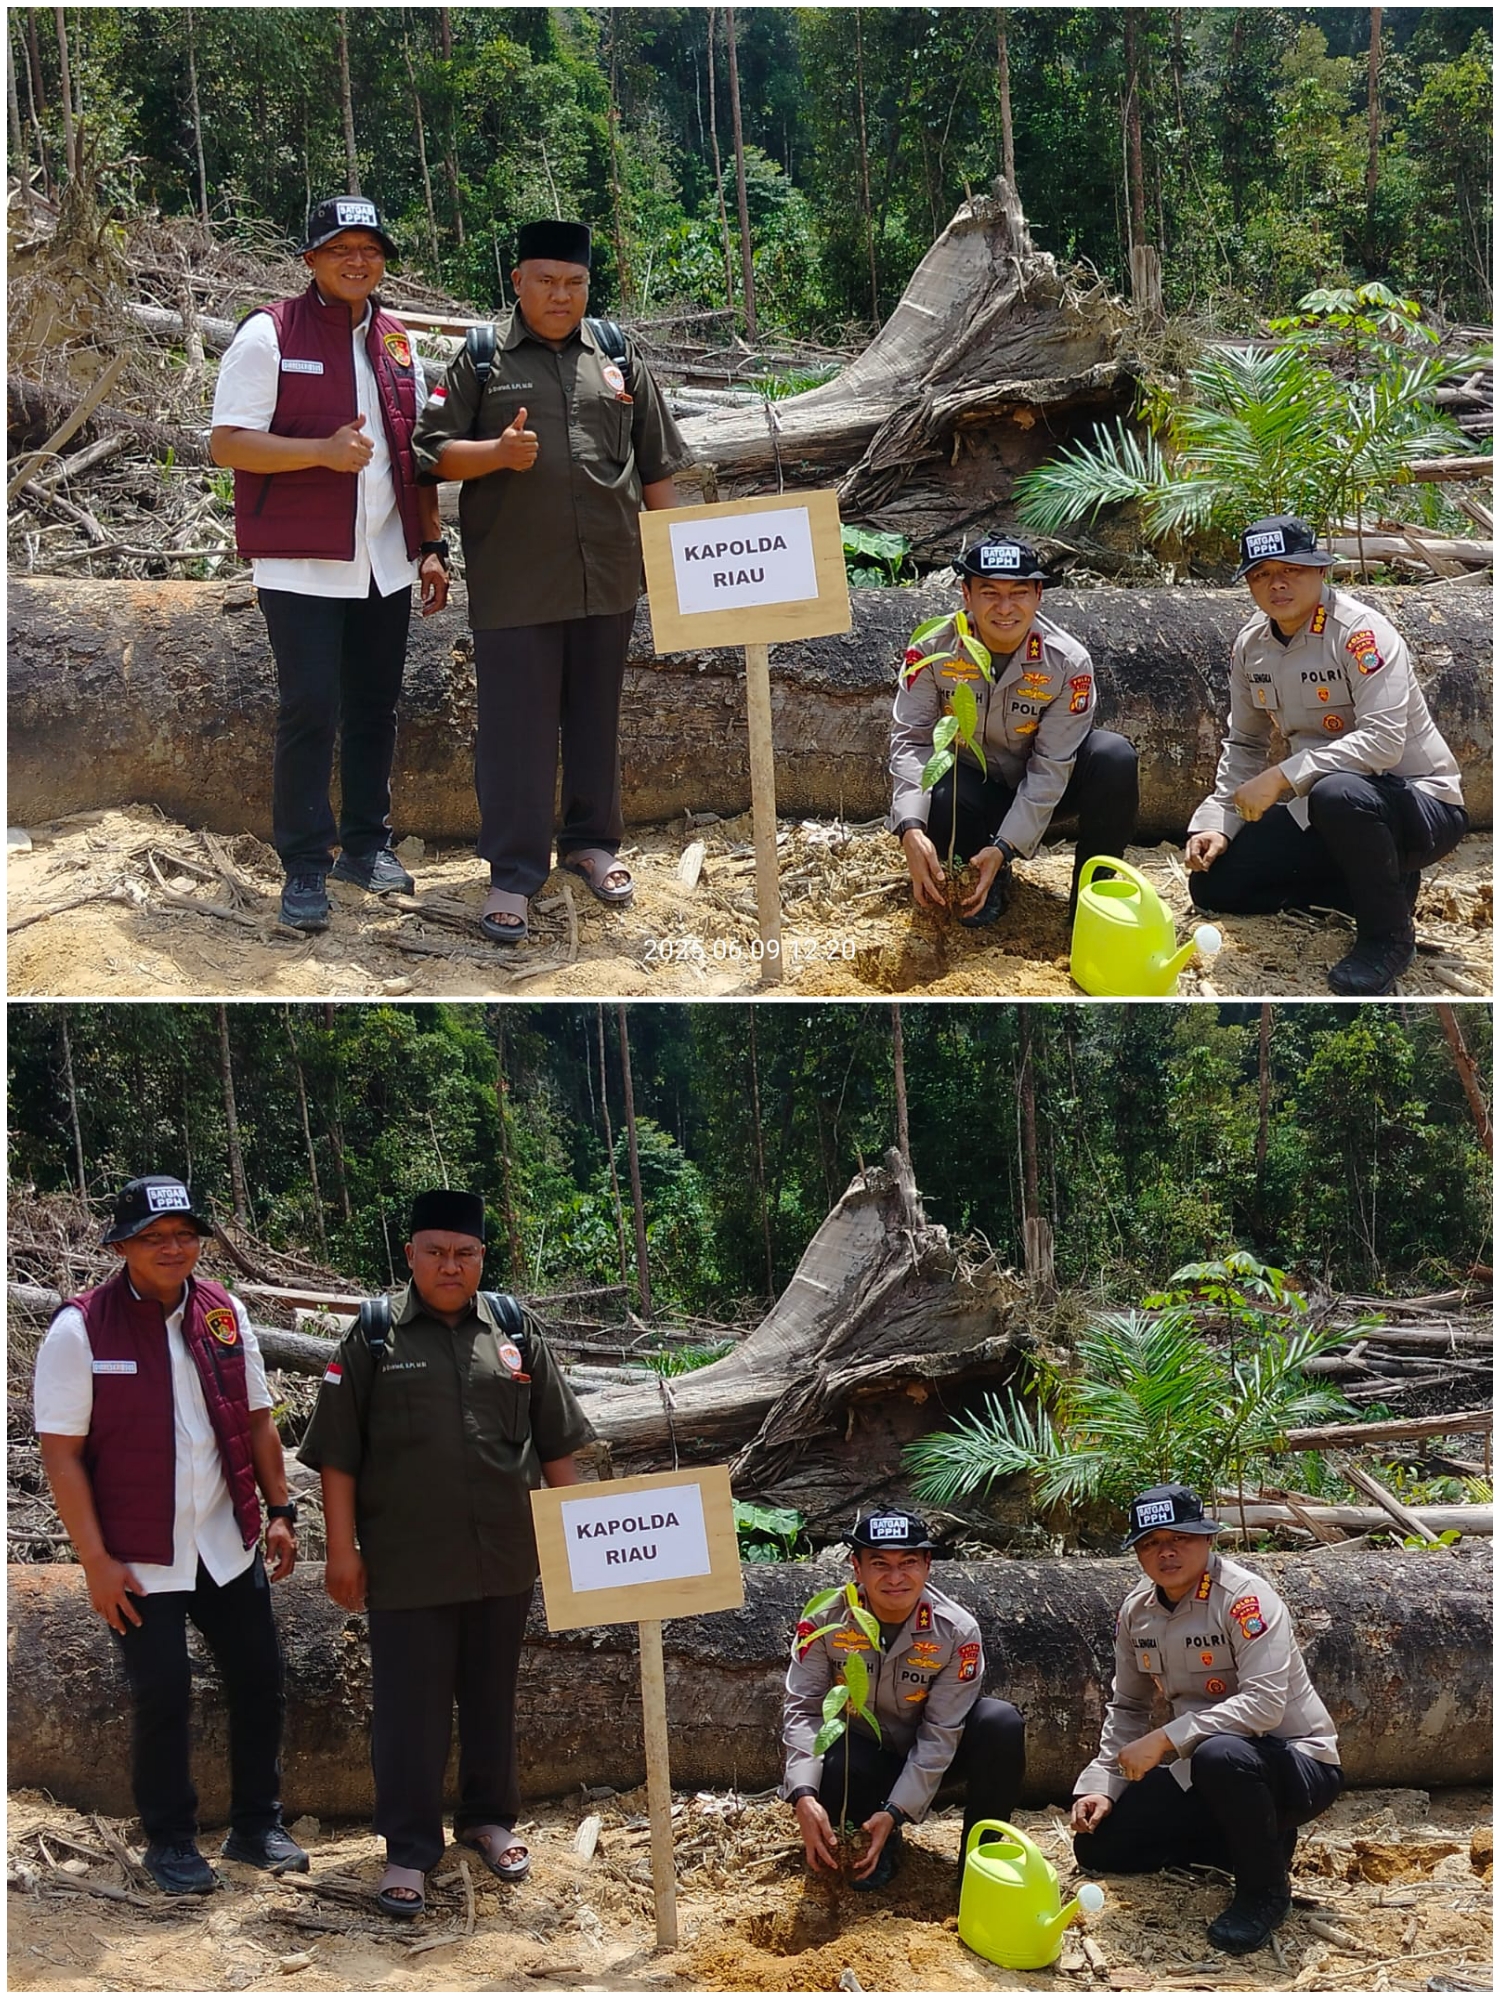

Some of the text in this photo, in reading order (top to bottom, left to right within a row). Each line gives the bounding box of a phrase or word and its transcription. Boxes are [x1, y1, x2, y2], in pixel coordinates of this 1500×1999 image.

[346, 214, 370, 223] PPH
[1249, 534, 1280, 547] SATGAS
[684, 535, 787, 562] KAPOLDA
[983, 549, 1017, 558] SATGAS
[1253, 543, 1277, 555] PPH
[988, 557, 1012, 566] PPH
[713, 567, 765, 588] RIAU
[1301, 668, 1342, 683] POLRI
[150, 1189, 185, 1200] SATGAS
[157, 1198, 183, 1208] PPH
[1140, 1503, 1171, 1516] SATGAS
[1143, 1512, 1168, 1524] PPH
[576, 1512, 680, 1539] KAPOLDA
[873, 1520, 905, 1529] SATGAS
[877, 1528, 901, 1537] PPH
[606, 1544, 657, 1565] RIAU
[1185, 1634, 1226, 1648] POLRI
